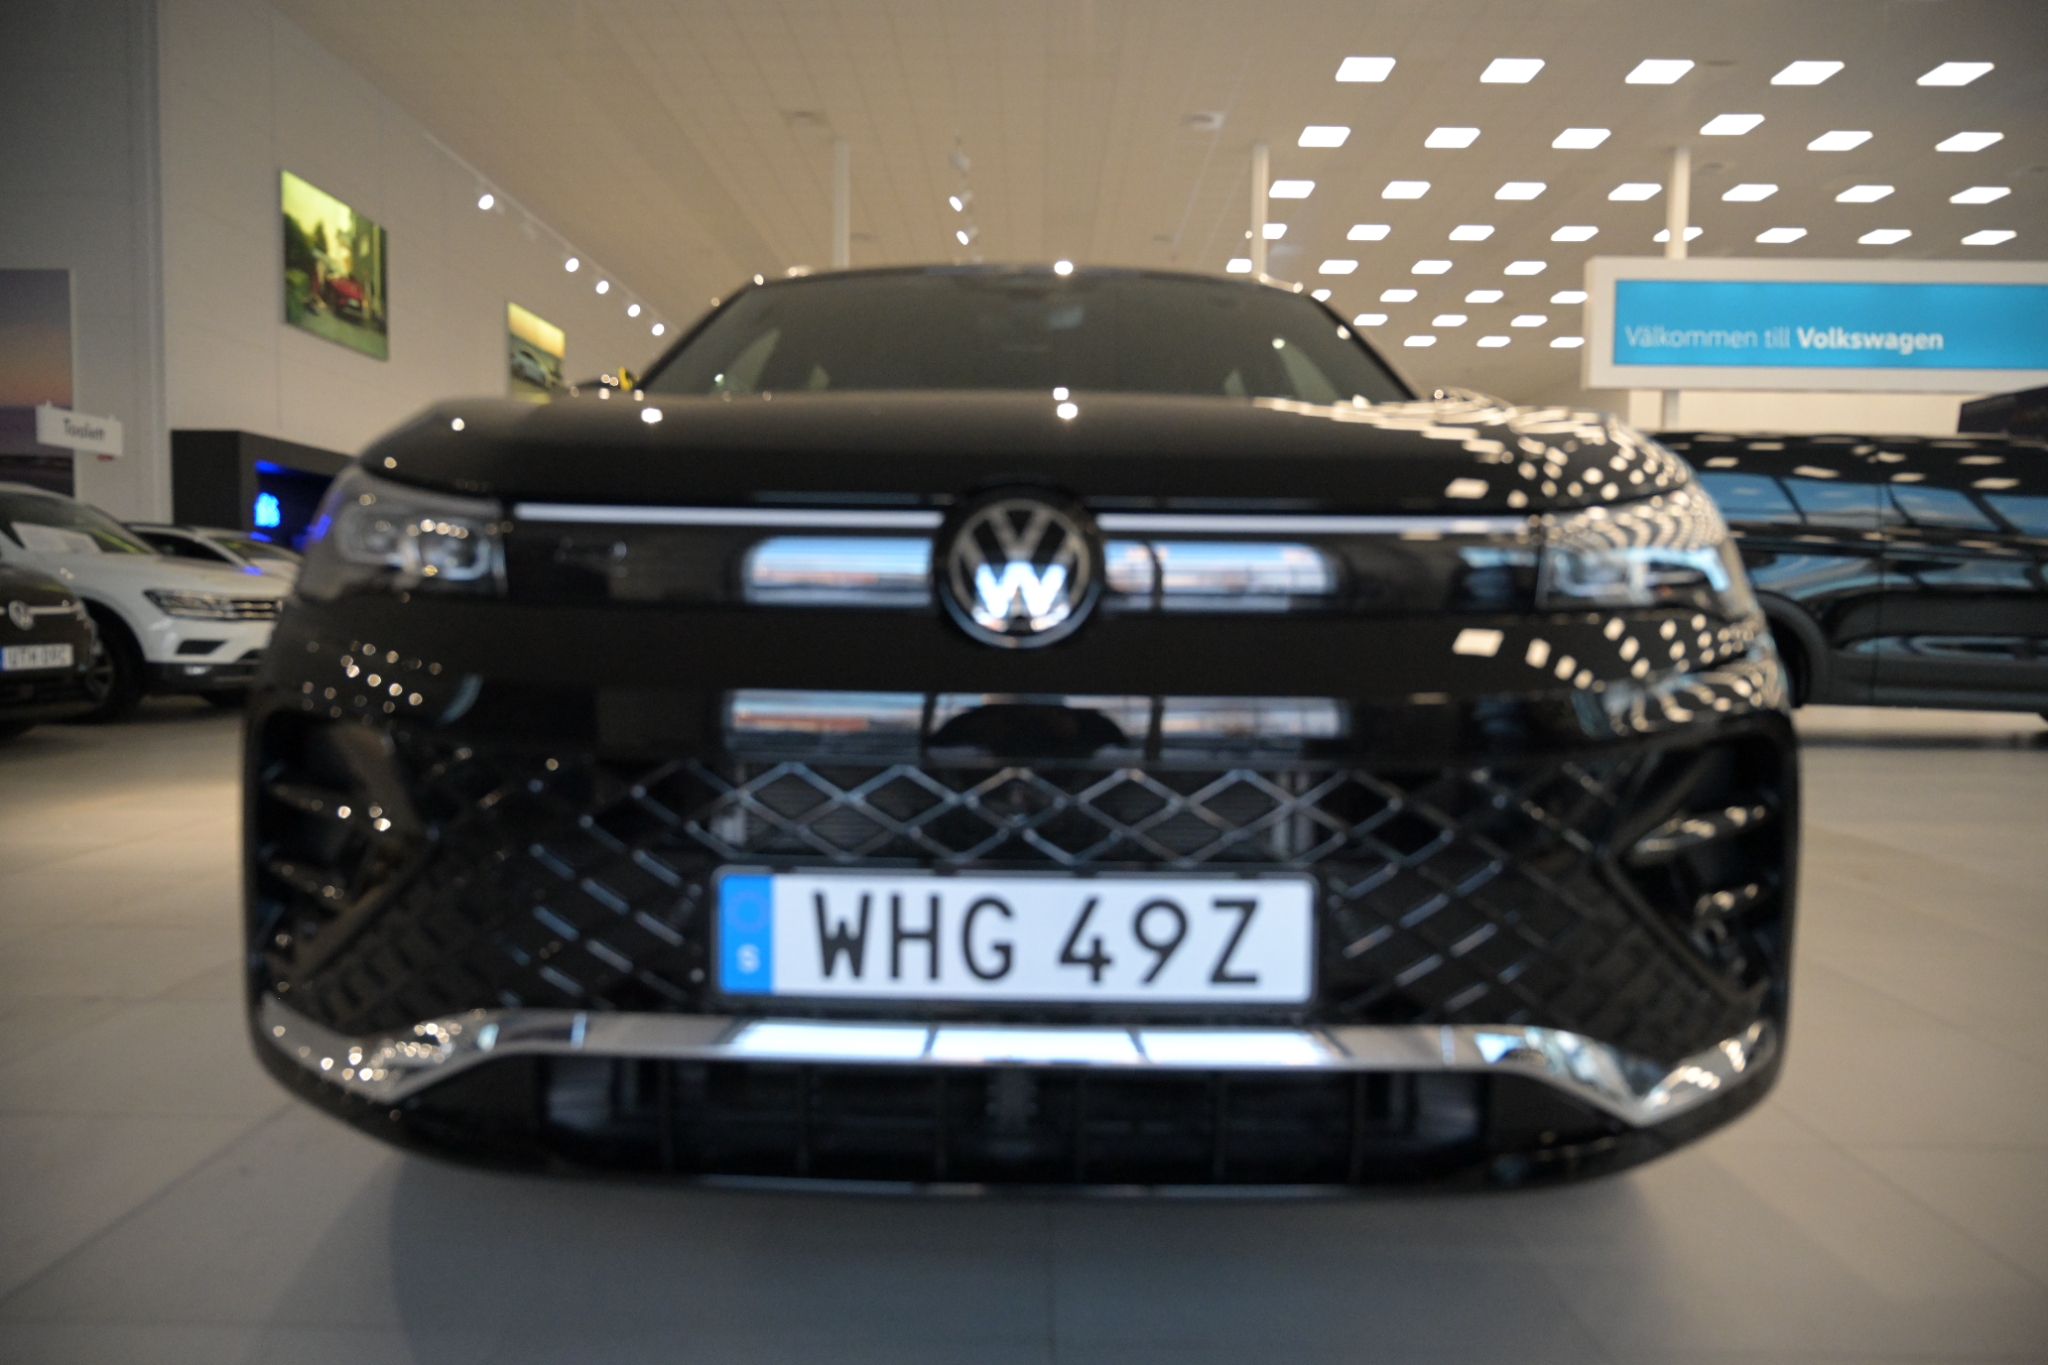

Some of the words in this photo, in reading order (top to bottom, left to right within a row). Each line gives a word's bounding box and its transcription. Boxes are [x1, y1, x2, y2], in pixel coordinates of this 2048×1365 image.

[1625, 325, 1758, 349] Välkommen
[1764, 326, 1791, 348] till
[1797, 326, 1944, 355] Volkswagen
[813, 893, 1014, 981] WHG
[1058, 896, 1260, 985] 49Z
